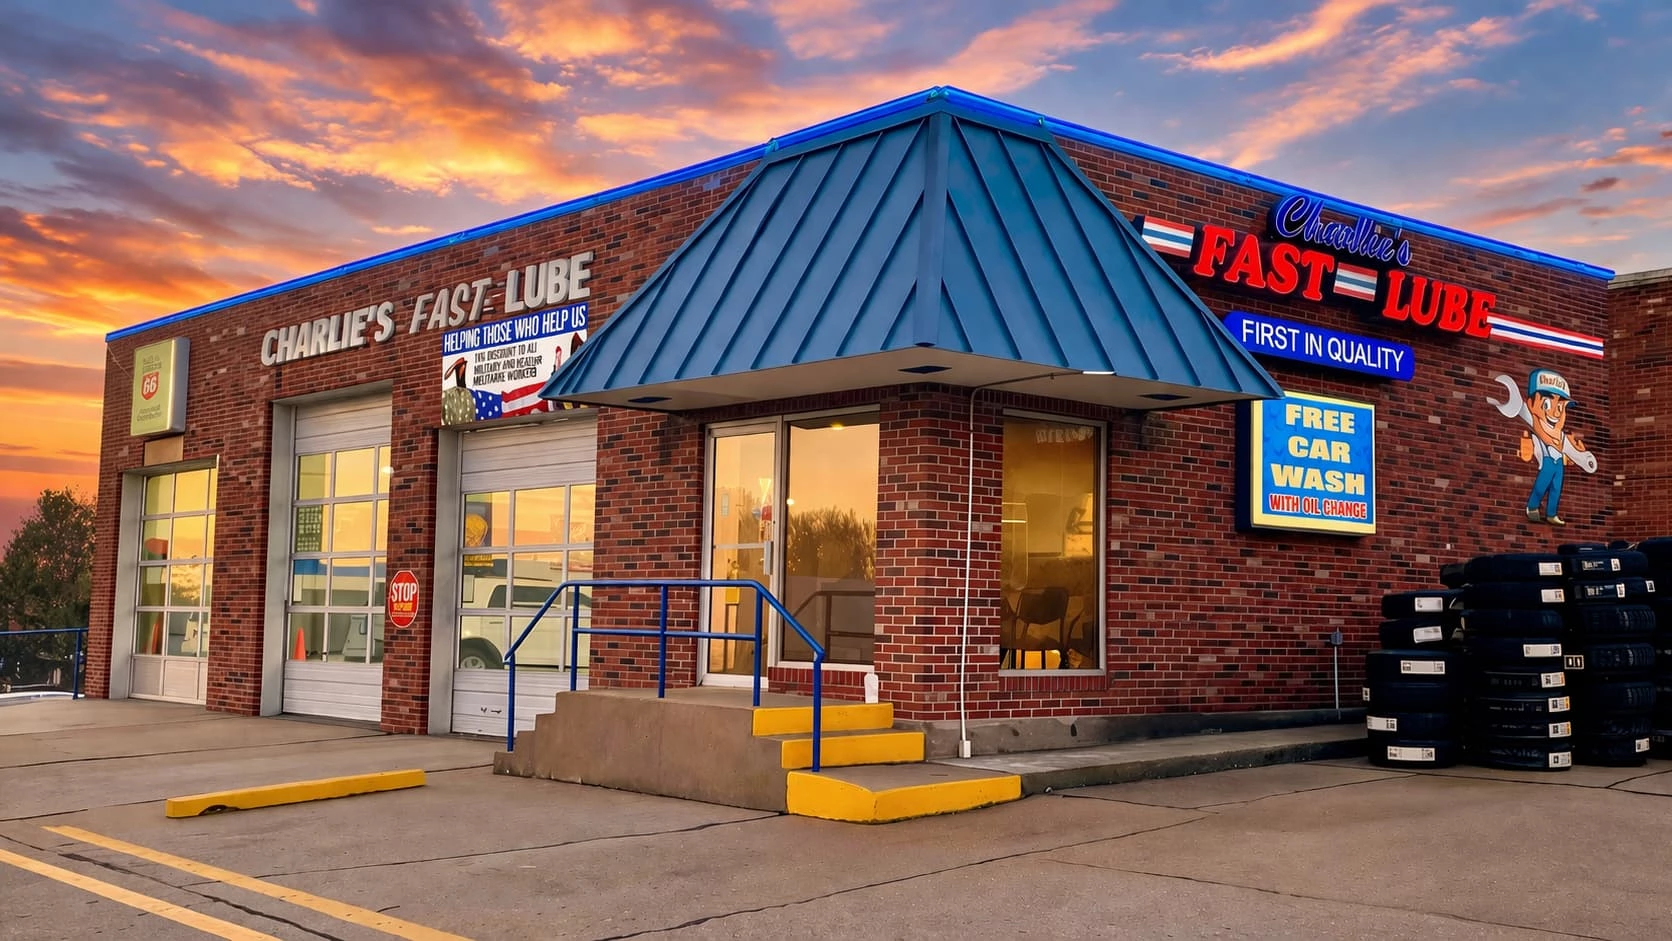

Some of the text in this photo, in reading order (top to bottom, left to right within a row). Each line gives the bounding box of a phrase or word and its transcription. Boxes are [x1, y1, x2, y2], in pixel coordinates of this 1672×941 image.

[1193, 224, 1497, 339] FAST LUBE
[261, 251, 594, 367] CHARLIE'S FAST LUBE
[444, 304, 586, 353] HELPING THOSE WHO HELP US
[518, 344, 526, 355] TO
[1242, 319, 1404, 372] FIRST IN QUALITY
[143, 375, 157, 394] 66
[1286, 403, 1355, 434] FREE
[1288, 436, 1351, 464] CAR
[1270, 463, 1365, 496] WASH
[1269, 493, 1367, 519] WITH OIL CHANGE
[391, 582, 417, 603] STOP
